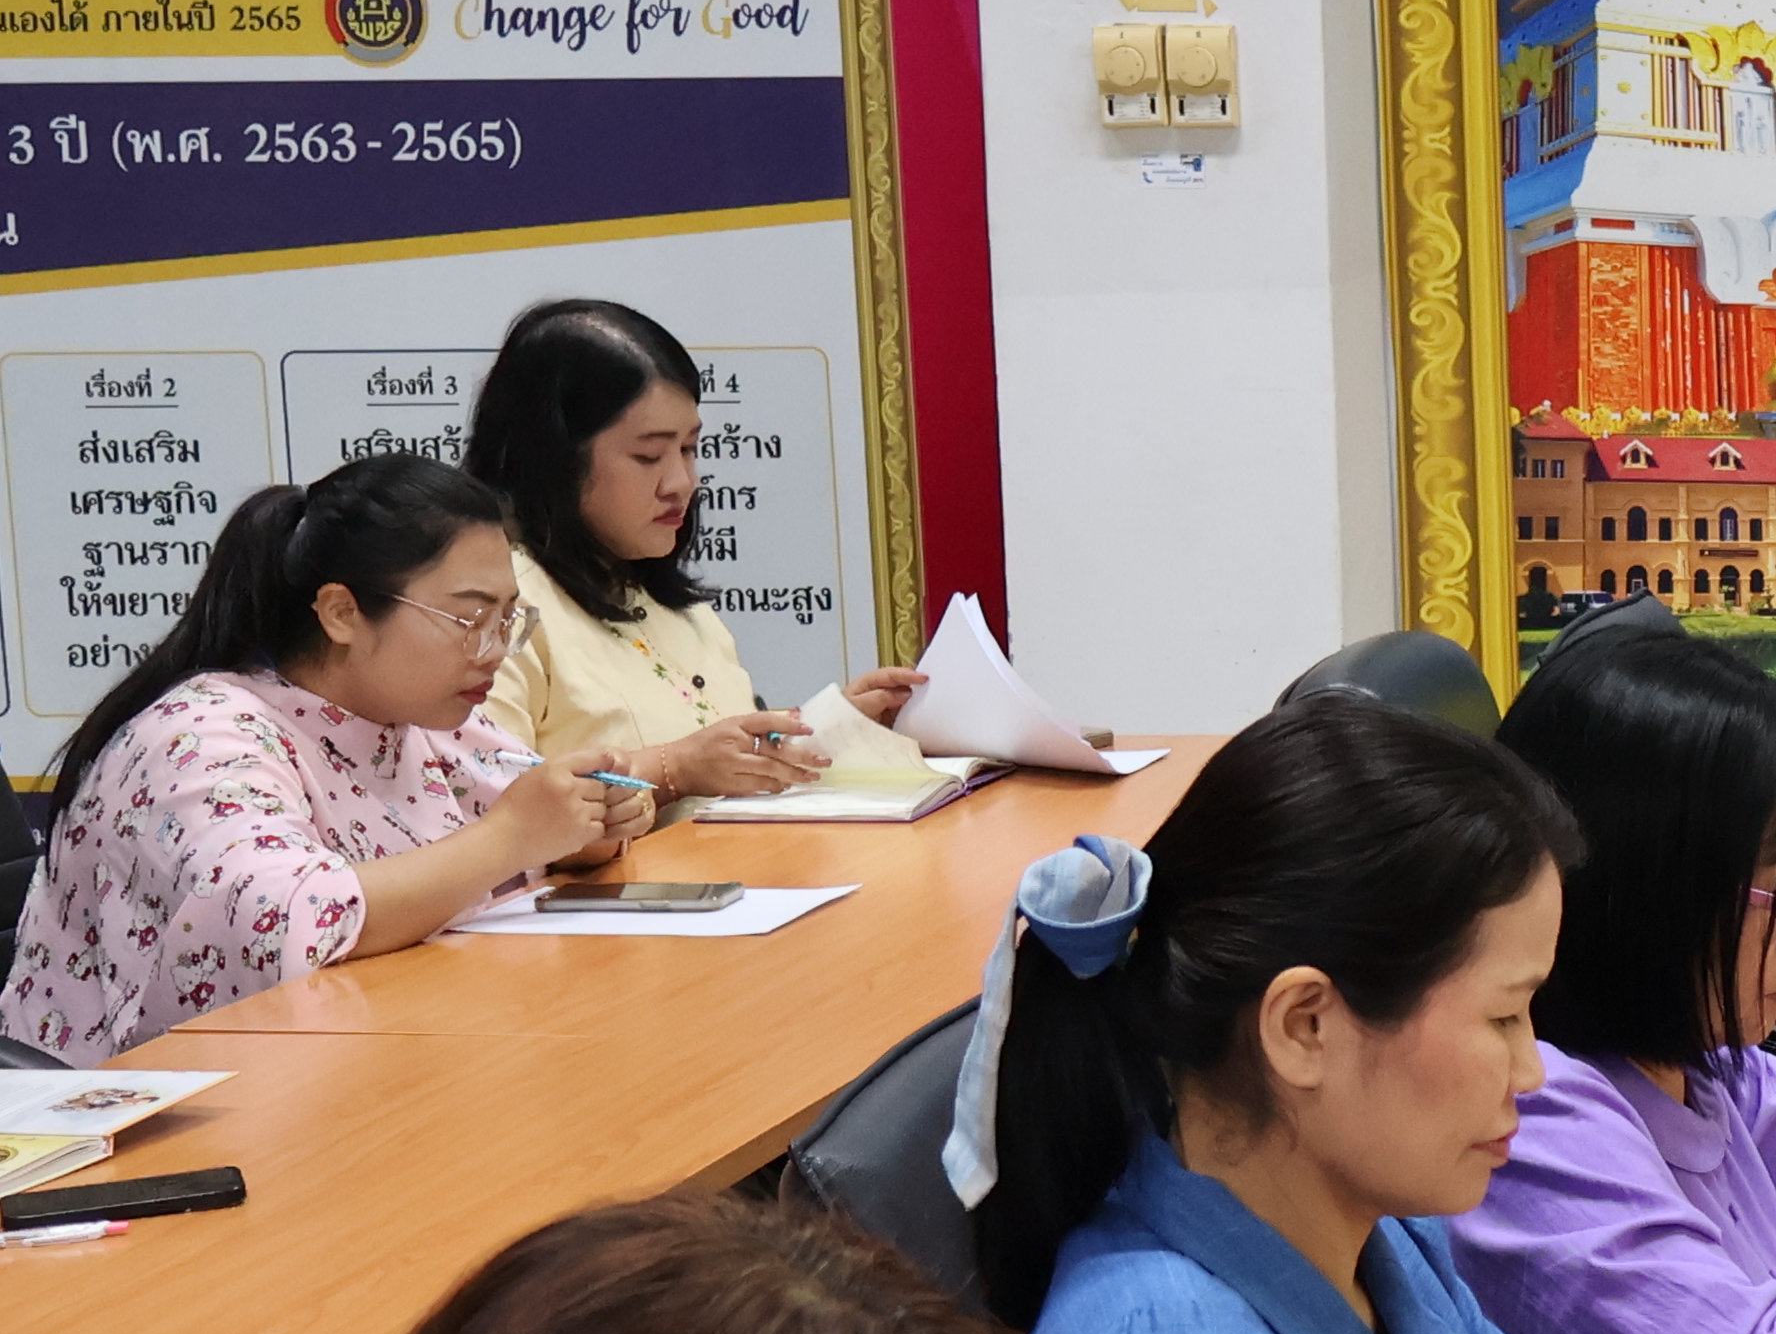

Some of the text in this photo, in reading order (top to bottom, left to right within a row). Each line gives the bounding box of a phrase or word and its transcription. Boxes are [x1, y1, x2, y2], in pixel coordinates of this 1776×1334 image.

[230, 3, 301, 33] 2565
[8, 125, 35, 165] 3
[49, 114, 88, 164] ปี
[112, 120, 223, 172] (พ.ศ.
[85, 368, 177, 398] เรื่องที่ 2
[366, 365, 459, 396] เรื่องที่ 3
[725, 373, 741, 394] 4
[78, 430, 201, 465] ส่งเสริม
[694, 423, 782, 460] สร้าง
[70, 481, 218, 526] เศรษฐกิจ
[83, 540, 212, 578] ฐานราก
